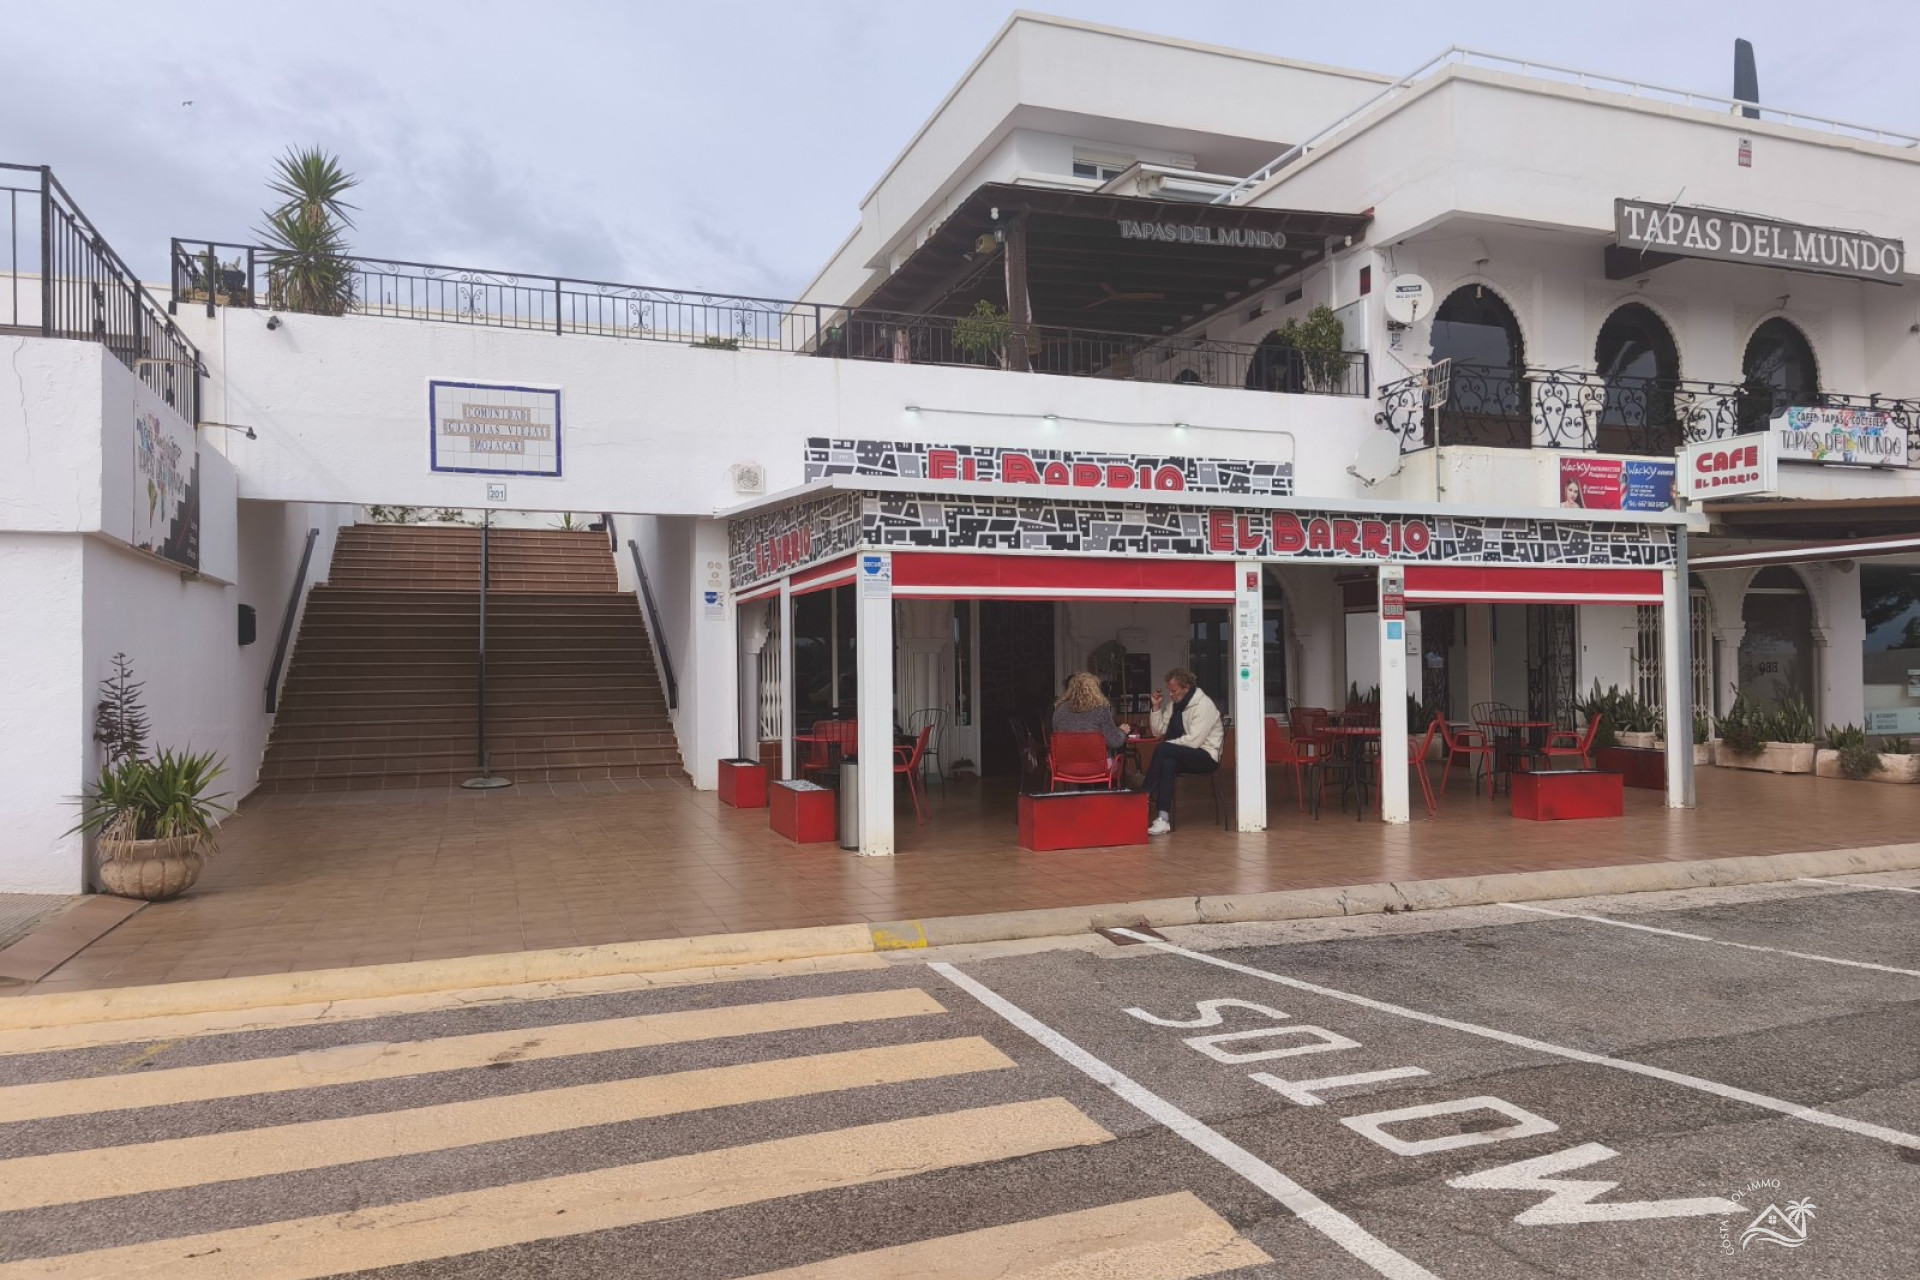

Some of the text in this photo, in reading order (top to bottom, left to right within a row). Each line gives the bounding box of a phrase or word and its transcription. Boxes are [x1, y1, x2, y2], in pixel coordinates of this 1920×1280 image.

[1118, 219, 1286, 249] TAPAS DEL MUNDO
[1624, 206, 1900, 275] TAPAS DEL MUNDO
[467, 408, 527, 421] COMUNIDAD
[1821, 413, 1844, 425] TAPAS
[448, 421, 546, 439] GUARDIAS VIEJAS
[1781, 429, 1901, 457] TAPAS DEL MUNDO
[474, 439, 519, 452] MOJACAR
[1696, 446, 1758, 473] CAFE
[489, 489, 504, 499] 201
[1695, 472, 1759, 490] EL BARRIO
[1209, 509, 1430, 556] EL BARRIO
[756, 524, 811, 576] EL BARRIO
[1122, 998, 1750, 1226] MOTOS
